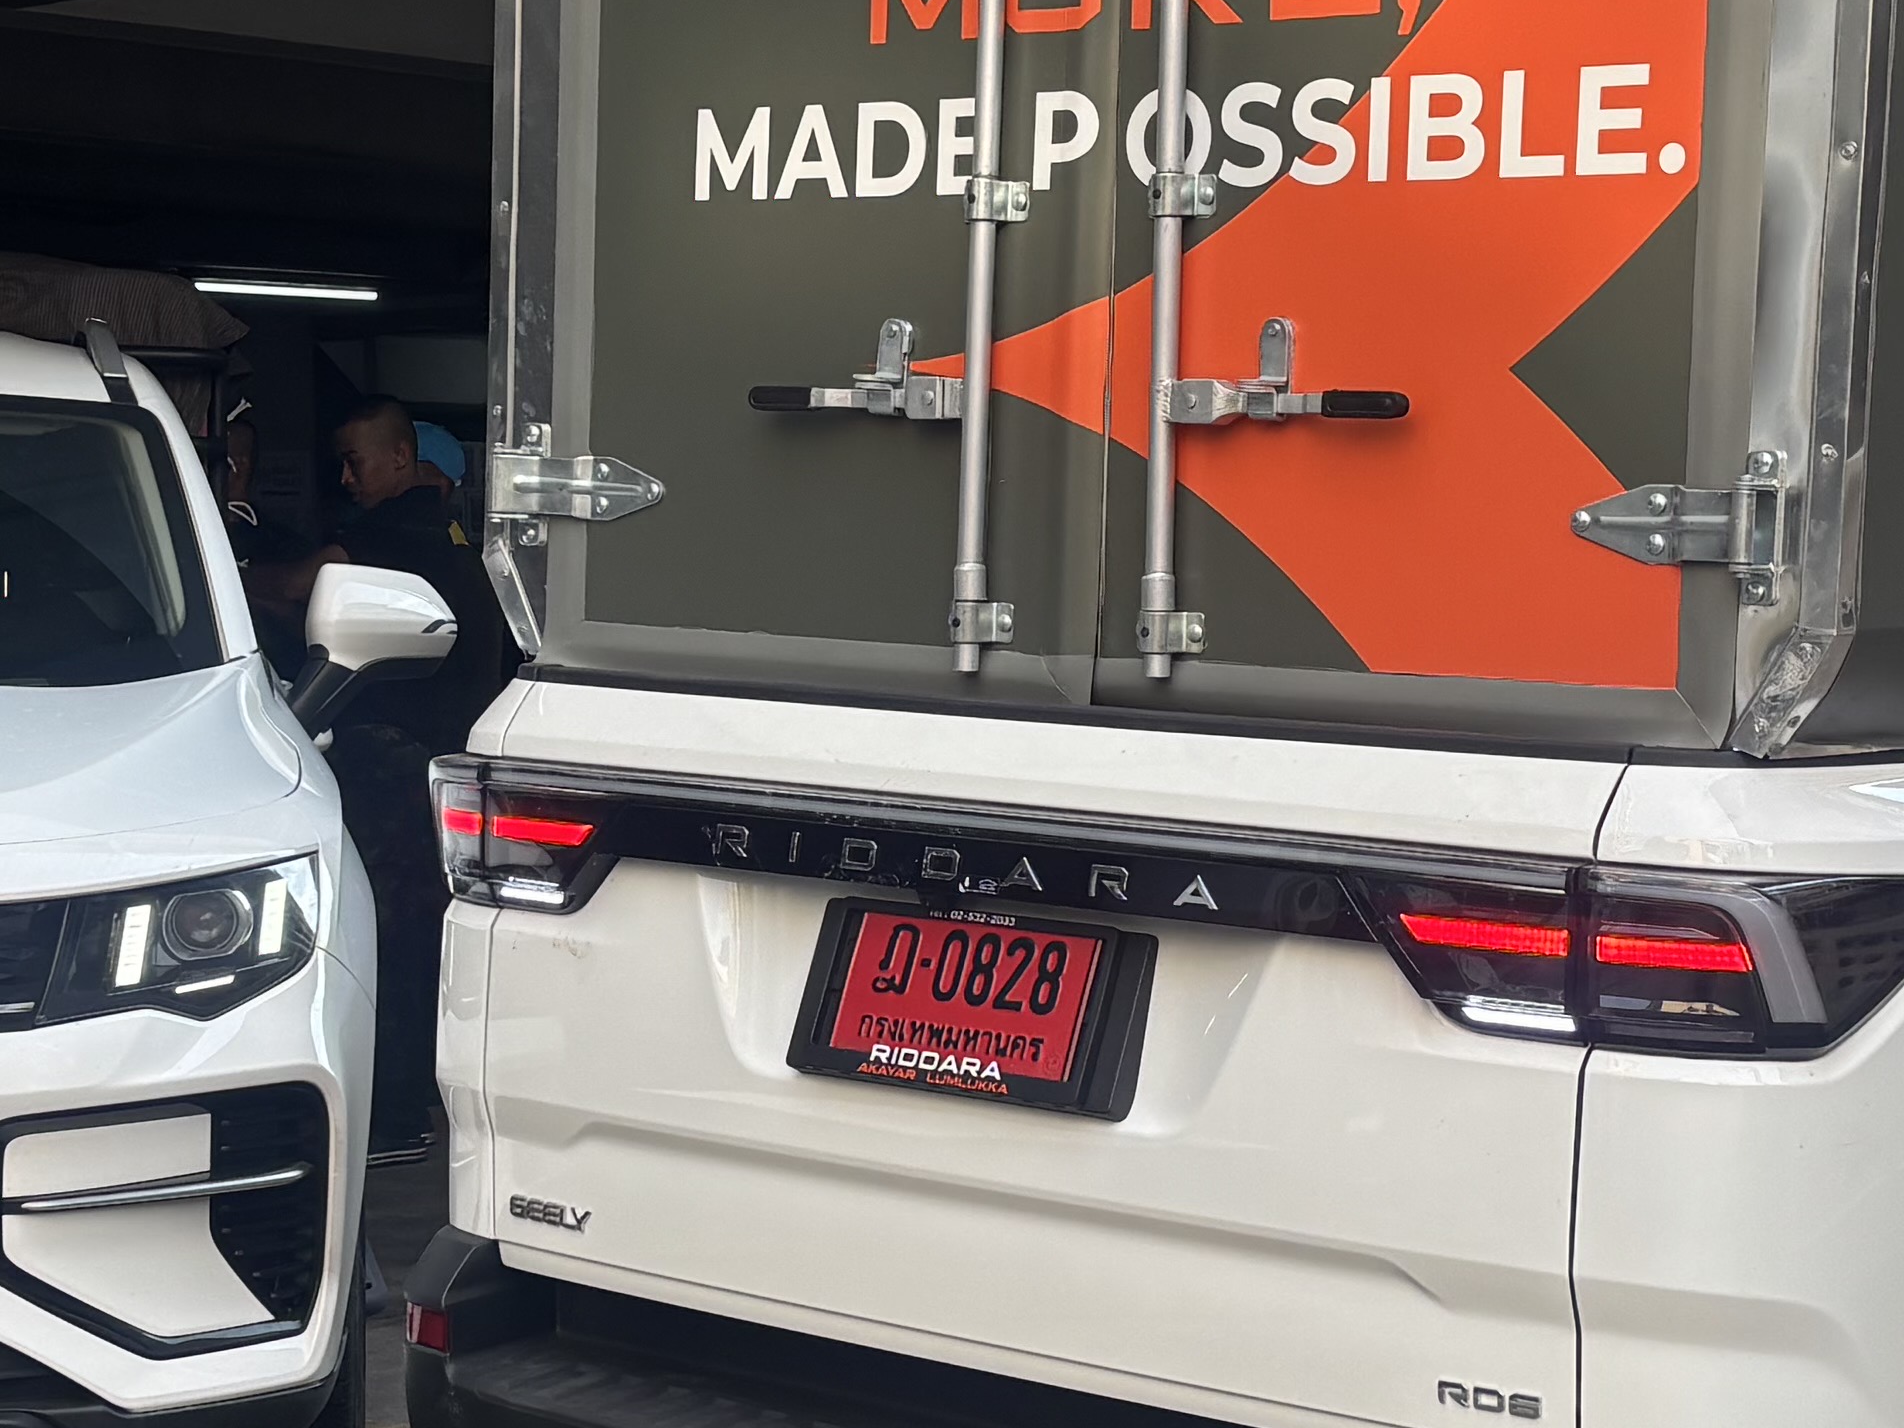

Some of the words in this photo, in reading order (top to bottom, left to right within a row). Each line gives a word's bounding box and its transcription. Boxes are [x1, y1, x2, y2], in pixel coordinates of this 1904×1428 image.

[694, 96, 976, 203] MADE
[1032, 62, 1685, 192] POSSIBLE.
[712, 822, 1219, 912] RIDDARA
[857, 1013, 1045, 1062] กรงเทพมหานคร
[856, 1061, 917, 1081] AKAYAR
[869, 1043, 1002, 1081] RIDDARA
[509, 1193, 592, 1234] GEELY
[1437, 1379, 1542, 1420] RD6
